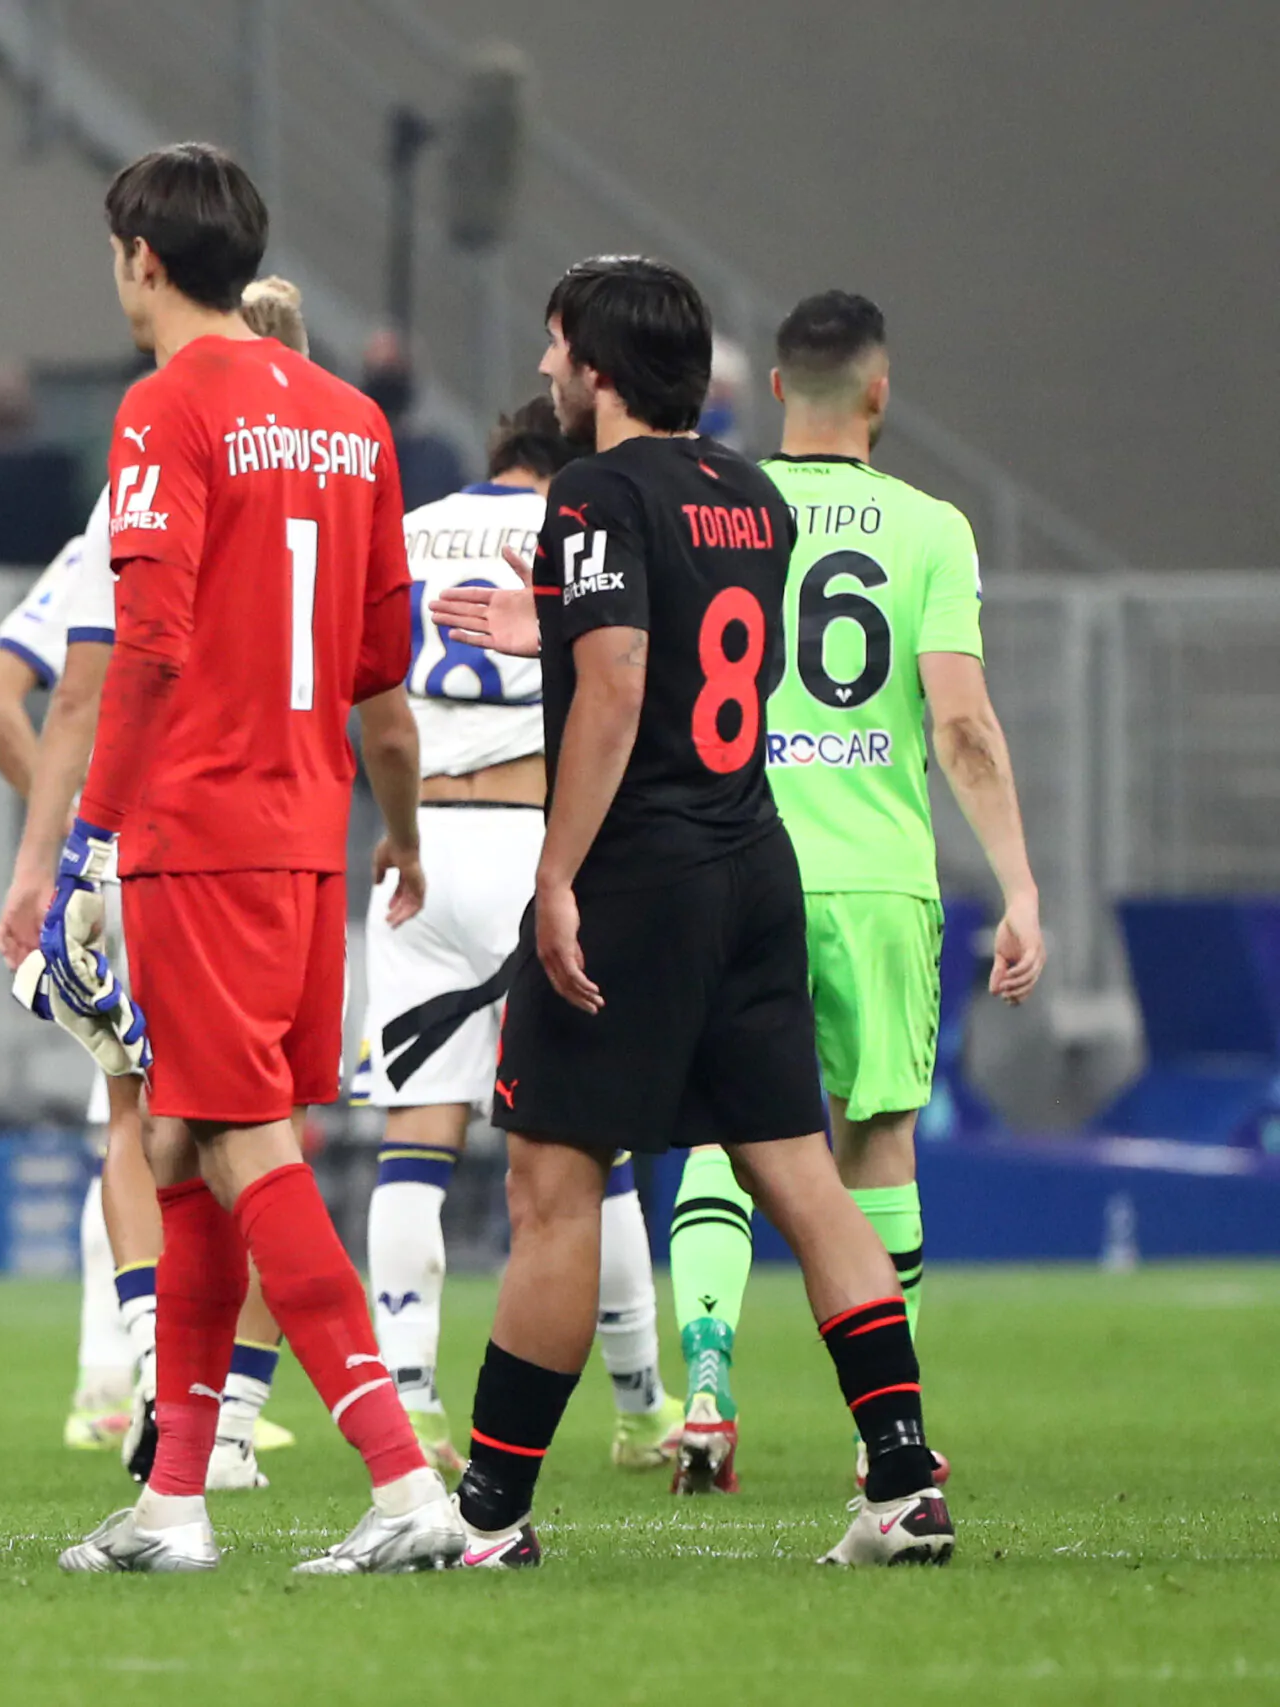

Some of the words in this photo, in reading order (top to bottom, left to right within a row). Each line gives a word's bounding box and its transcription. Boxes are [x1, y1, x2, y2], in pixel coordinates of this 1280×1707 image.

[681, 504, 774, 549] TONALI
[787, 496, 881, 534] TIPÒ
[286, 518, 318, 711] 1
[767, 550, 892, 710] 6
[691, 586, 766, 774] 8
[766, 732, 891, 764] ROCAR
